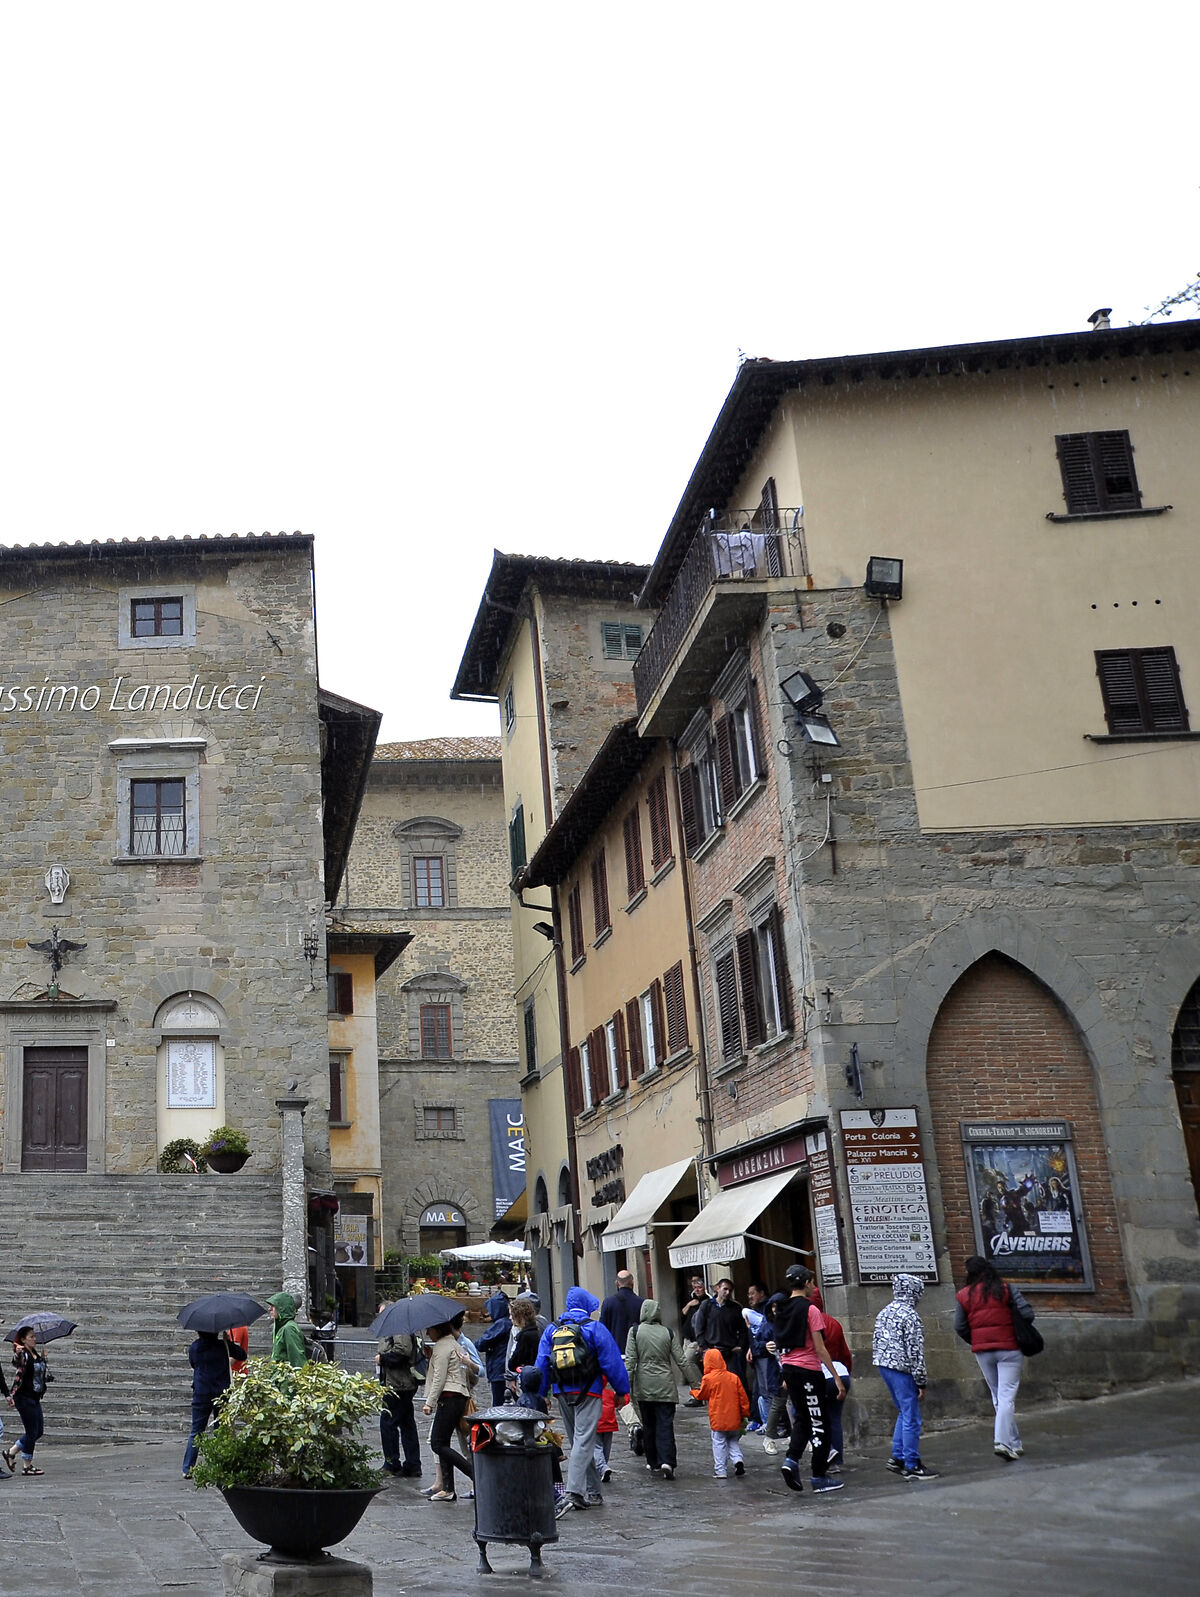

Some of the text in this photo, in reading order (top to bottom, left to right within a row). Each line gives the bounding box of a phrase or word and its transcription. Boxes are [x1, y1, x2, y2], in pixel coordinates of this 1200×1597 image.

[845, 1132, 901, 1141] Porta Colonia
[847, 1149, 908, 1158] Palazzo Mancini
[732, 1146, 785, 1179] LORENZINI
[873, 1170, 922, 1179] PRELUDIO
[863, 1205, 926, 1215] ENOTECA
[991, 1231, 1072, 1255] AVENGERS
[869, 1273, 888, 1281] Città
[806, 1395, 825, 1436] REAL
